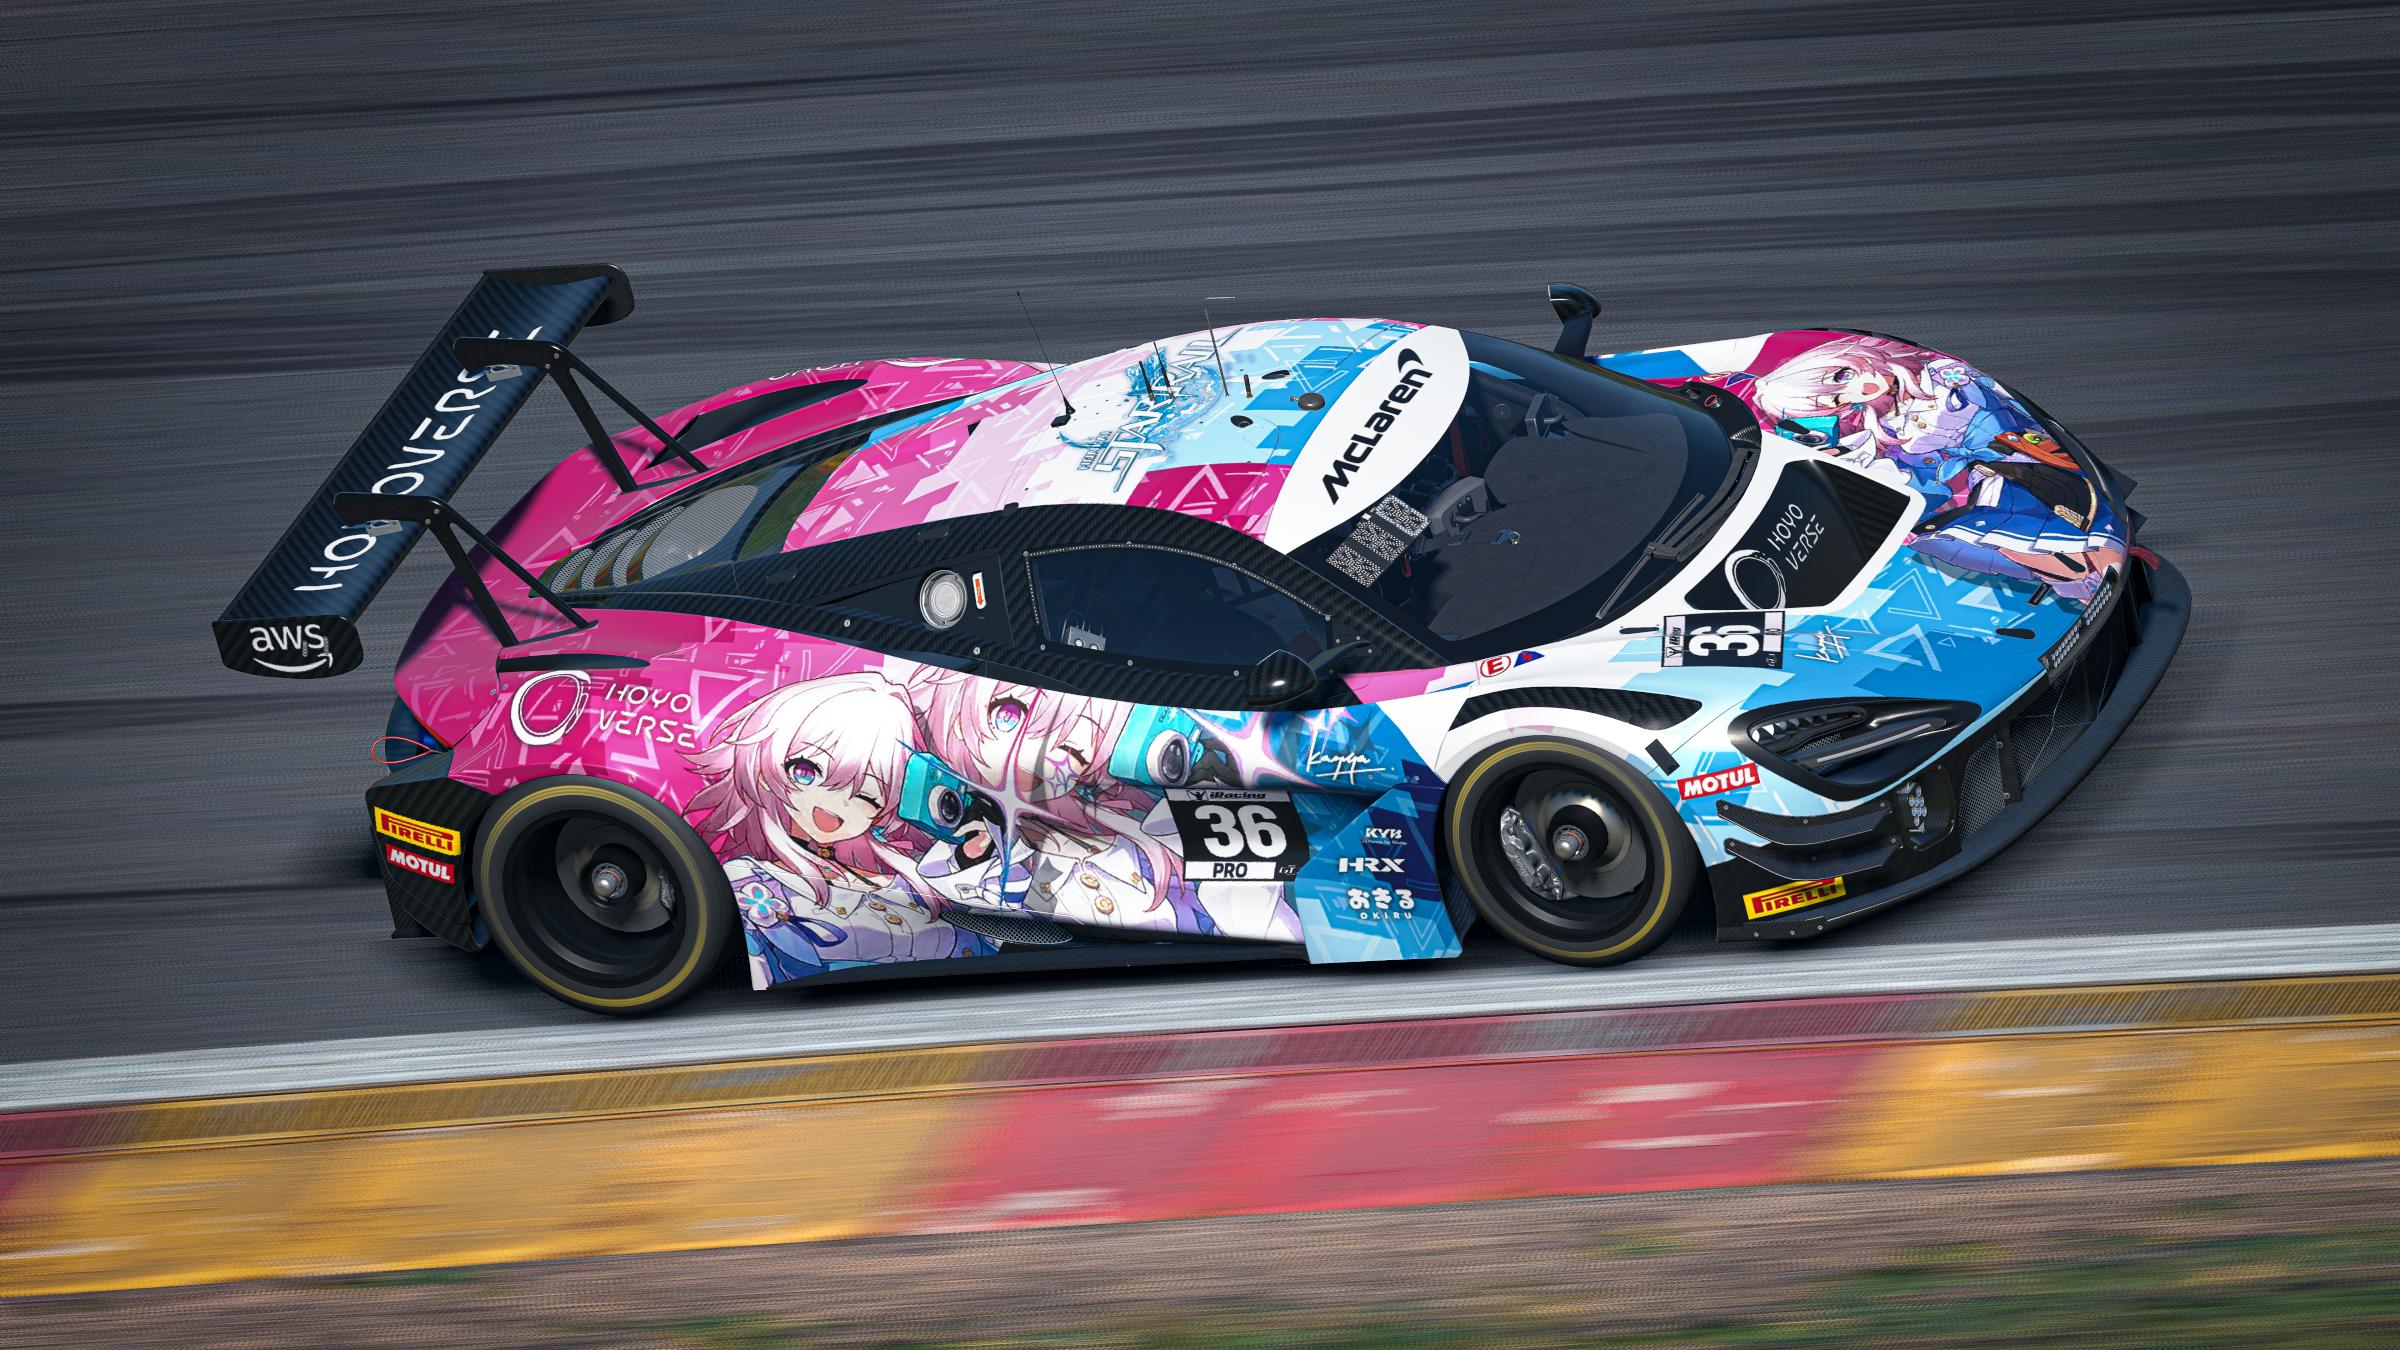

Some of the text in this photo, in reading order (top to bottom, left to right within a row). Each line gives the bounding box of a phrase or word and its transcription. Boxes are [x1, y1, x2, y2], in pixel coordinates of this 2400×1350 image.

[1322, 368, 1433, 505] McLaren
[1767, 504, 1804, 551] HOYO
[1785, 514, 1825, 570] VERSE
[250, 623, 325, 652] aws
[605, 682, 692, 713] HOYO
[599, 708, 701, 749] VERSE
[1209, 791, 1266, 800] iRacing
[1683, 767, 1756, 797] MOTUL
[380, 812, 454, 852] PIRELLI
[1194, 804, 1288, 859] 36
[390, 848, 451, 881] MOTUL
[1212, 862, 1248, 878] PRO
[1338, 857, 1406, 873] HRX
[1347, 887, 1415, 910] おきる
[1751, 877, 1838, 914] PIRELLI
[1360, 911, 1413, 920] OKIRU
